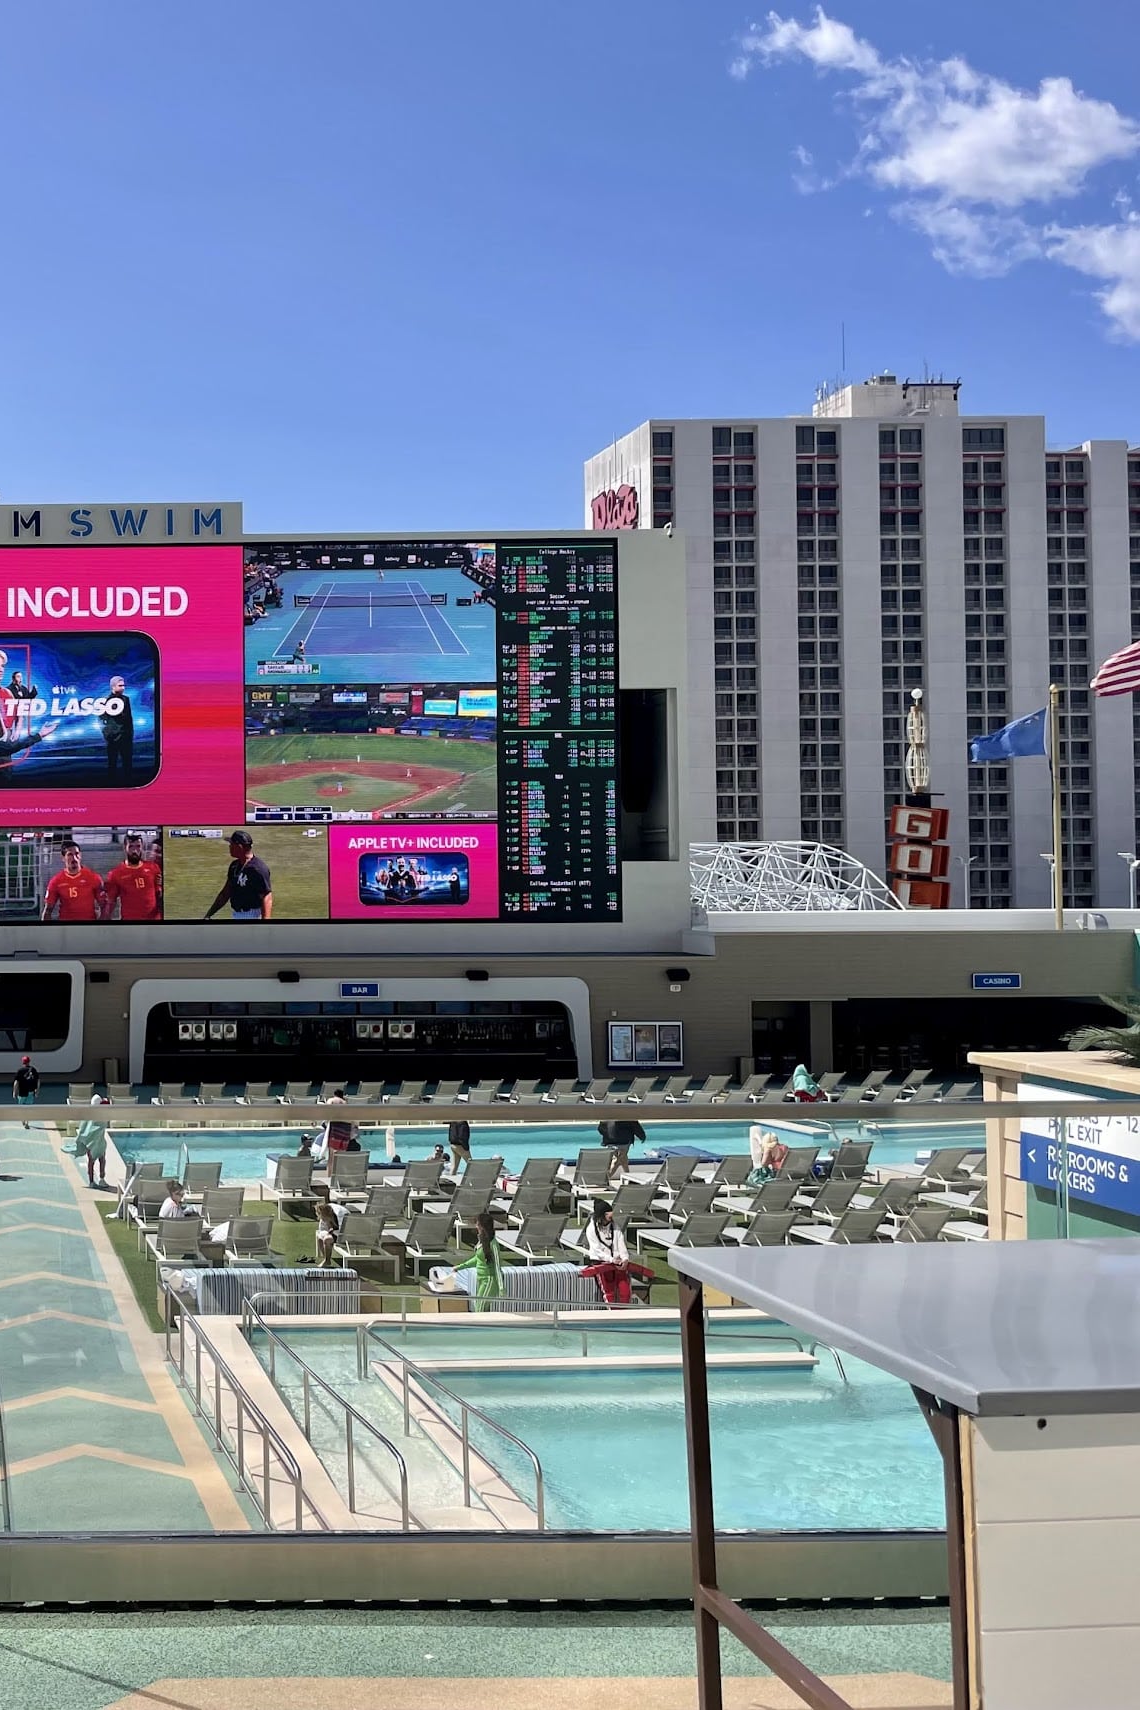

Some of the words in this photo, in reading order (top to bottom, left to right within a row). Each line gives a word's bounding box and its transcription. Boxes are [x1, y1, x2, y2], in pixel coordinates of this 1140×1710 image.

[69, 508, 224, 537] SWIM
[7, 585, 189, 618] INCLUDED
[4, 698, 47, 716] TED
[51, 697, 125, 716] LASSO
[348, 838, 387, 849] APPLE
[390, 837, 414, 848] TV+
[417, 837, 479, 848] INCLUDED
[135, 877, 145, 888] 19
[68, 887, 78, 898] 15
[983, 977, 1012, 985] CASINO
[1077, 1125, 1102, 1144] EXIT
[1119, 1164, 1129, 1182] &
